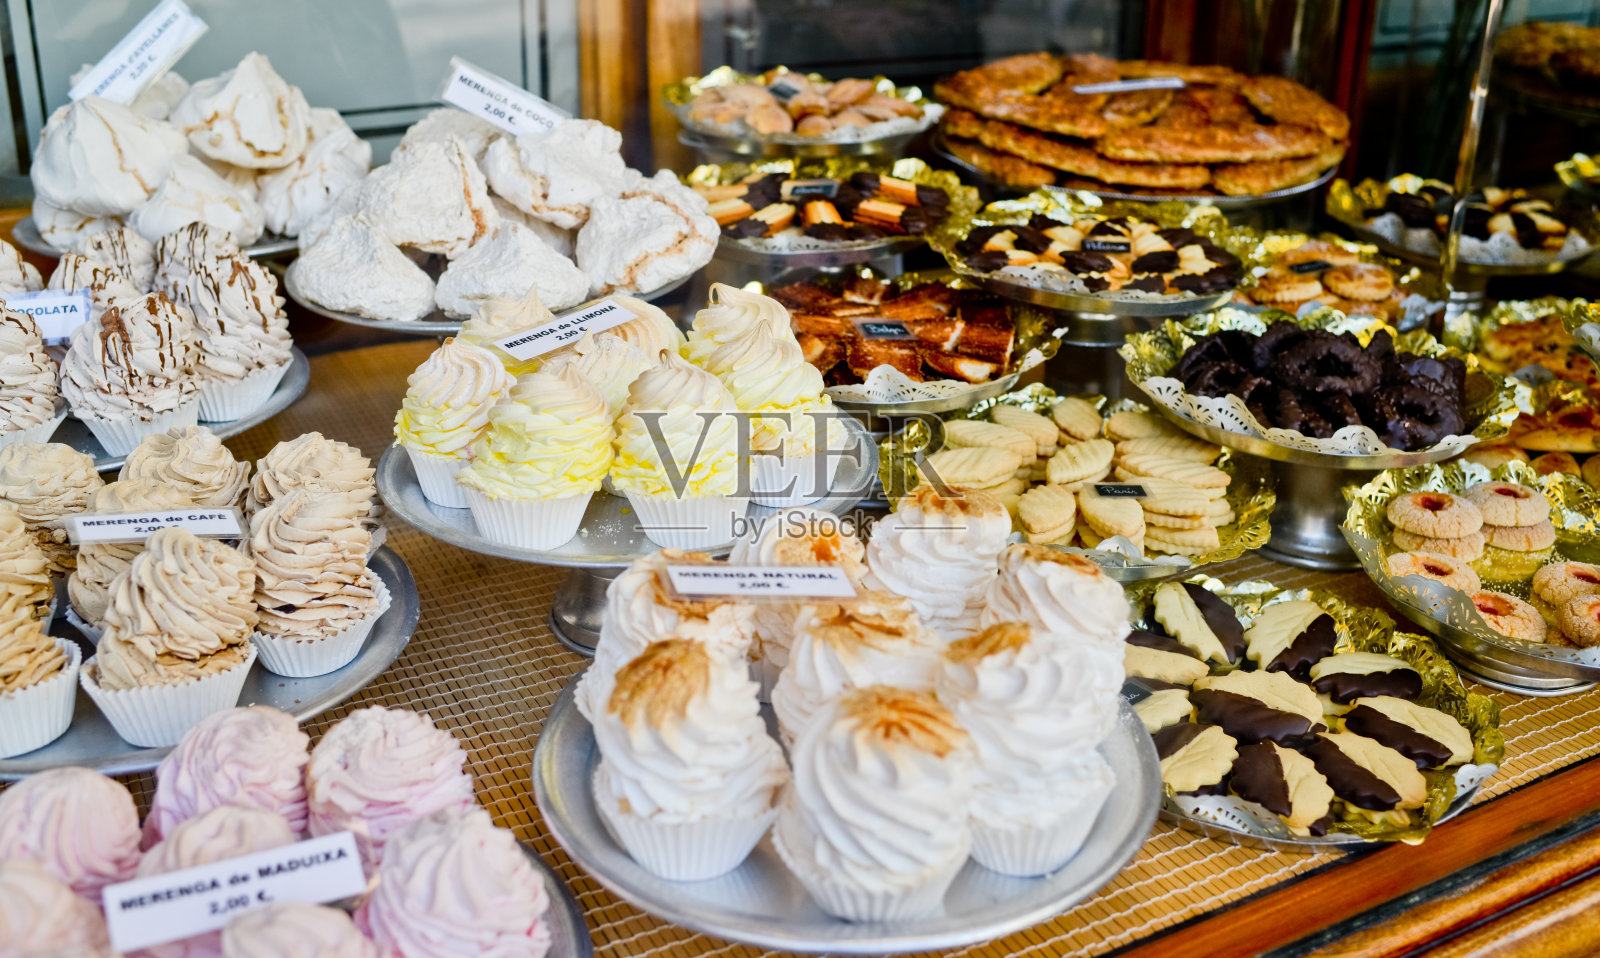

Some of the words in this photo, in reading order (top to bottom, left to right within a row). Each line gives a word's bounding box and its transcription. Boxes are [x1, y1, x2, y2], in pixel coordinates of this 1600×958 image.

[93, 64, 127, 96] ERENGA
[459, 75, 508, 105] MERENGA
[510, 102, 523, 113] de
[525, 109, 554, 129] COCO
[483, 103, 506, 119] 2,00
[504, 328, 558, 349] MERENGA
[558, 323, 572, 331] de
[571, 304, 617, 325] LLIMONA
[555, 330, 579, 341] 2,00
[82, 517, 160, 527] MERENGA
[678, 571, 758, 579] MERENGA
[119, 879, 220, 911] MERENGA
[229, 874, 250, 886] de
[257, 848, 348, 879] MADUIXA
[210, 895, 249, 915] 2,00
